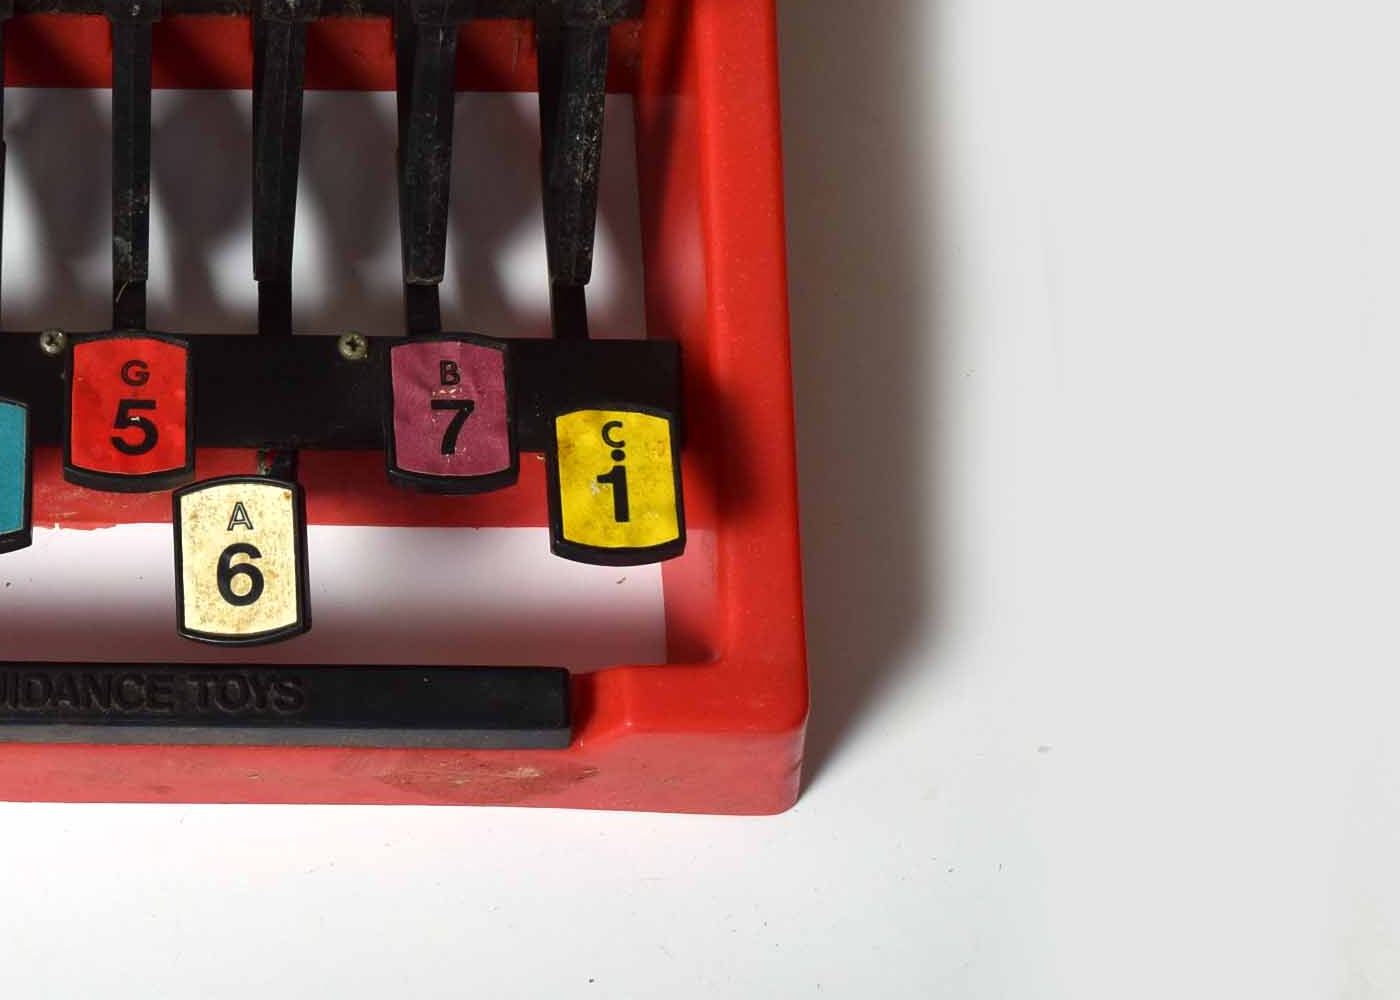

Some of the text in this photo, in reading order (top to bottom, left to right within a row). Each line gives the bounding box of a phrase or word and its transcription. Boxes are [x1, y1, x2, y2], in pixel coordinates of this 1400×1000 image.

[120, 359, 150, 386] G
[439, 359, 461, 386] B
[110, 399, 159, 456] 5
[431, 399, 475, 456] 7
[601, 420, 626, 448] C
[226, 501, 254, 531] A
[216, 542, 265, 607] 6
[184, 672, 305, 714] TOYS
